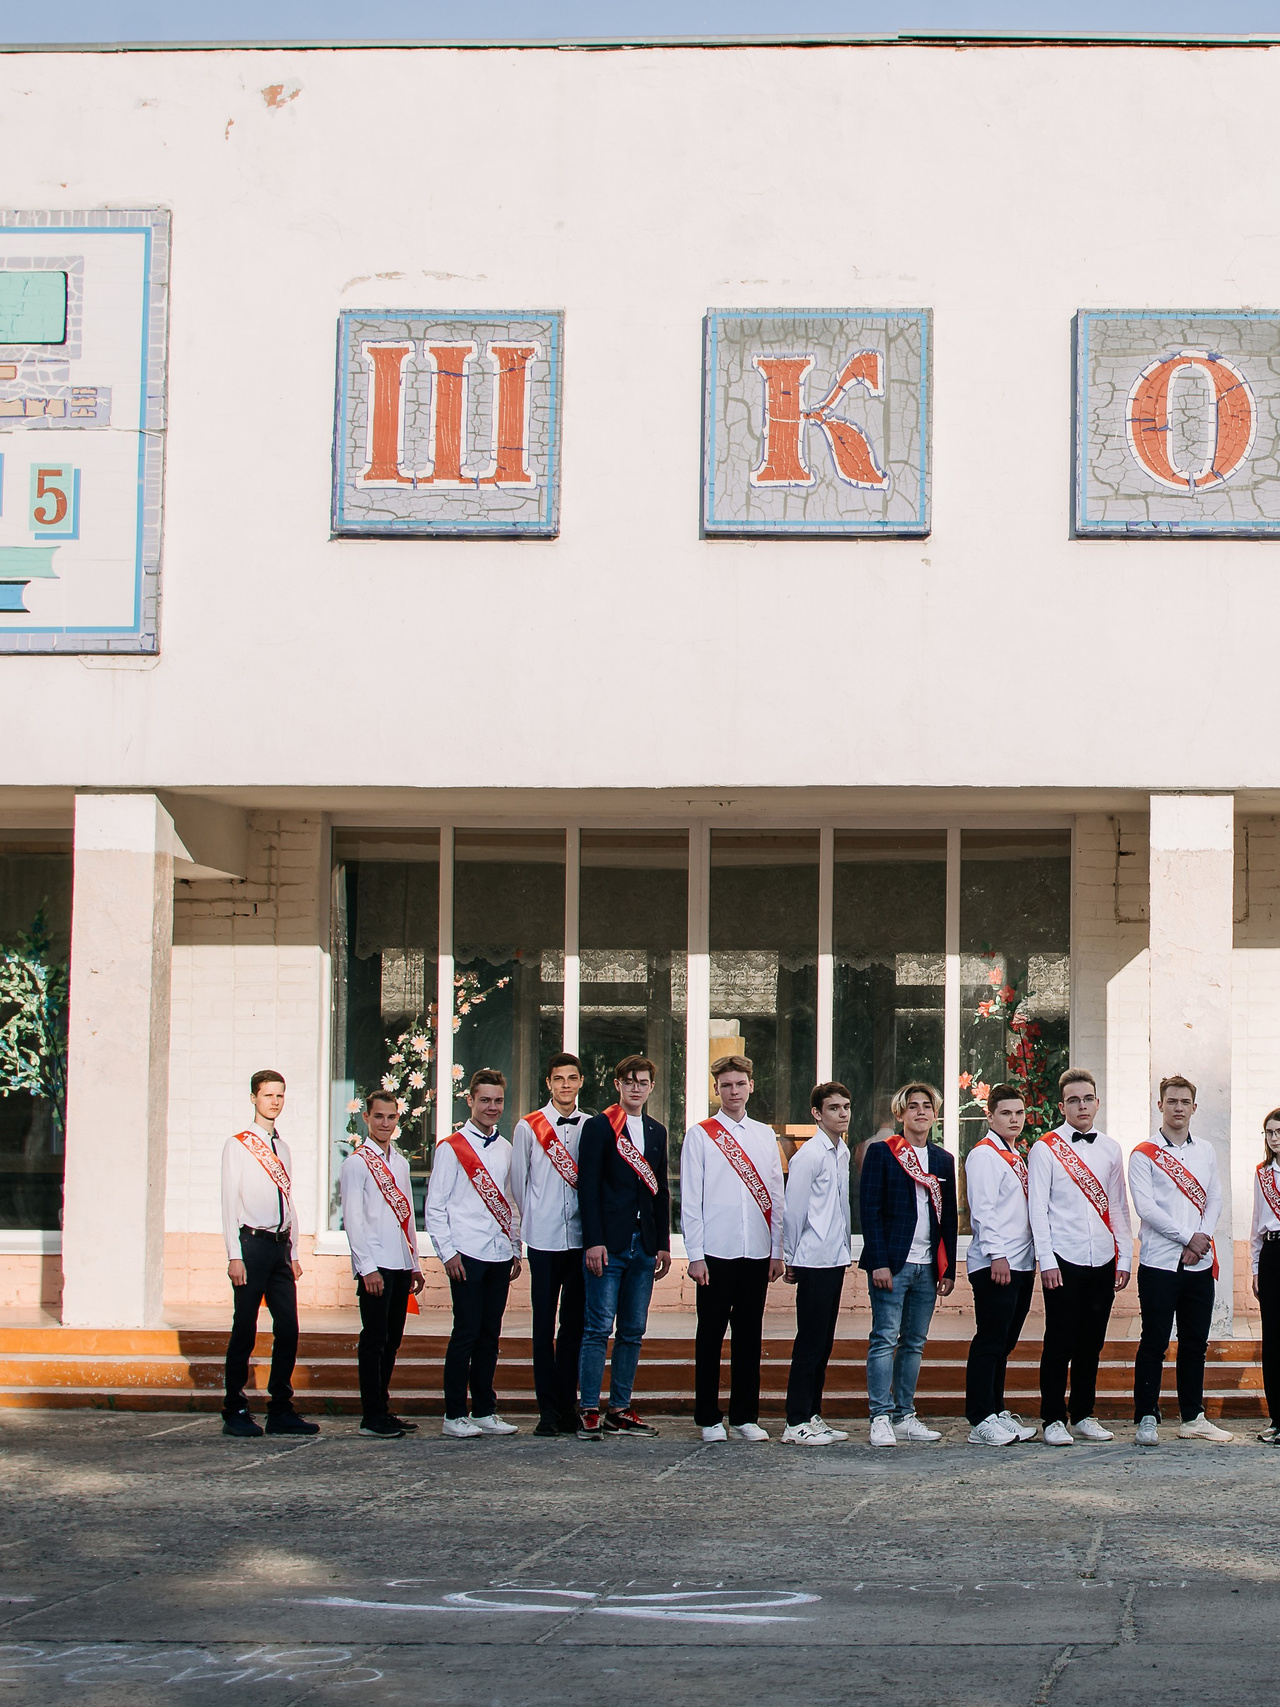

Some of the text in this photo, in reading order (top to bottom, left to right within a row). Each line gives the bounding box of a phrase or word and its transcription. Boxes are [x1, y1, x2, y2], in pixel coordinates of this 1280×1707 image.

[33, 468, 68, 526] 5
[725, 1144, 763, 1191] Выпускник
[758, 1189, 771, 1209] 2023
[1061, 1150, 1102, 1195] Выпускник
